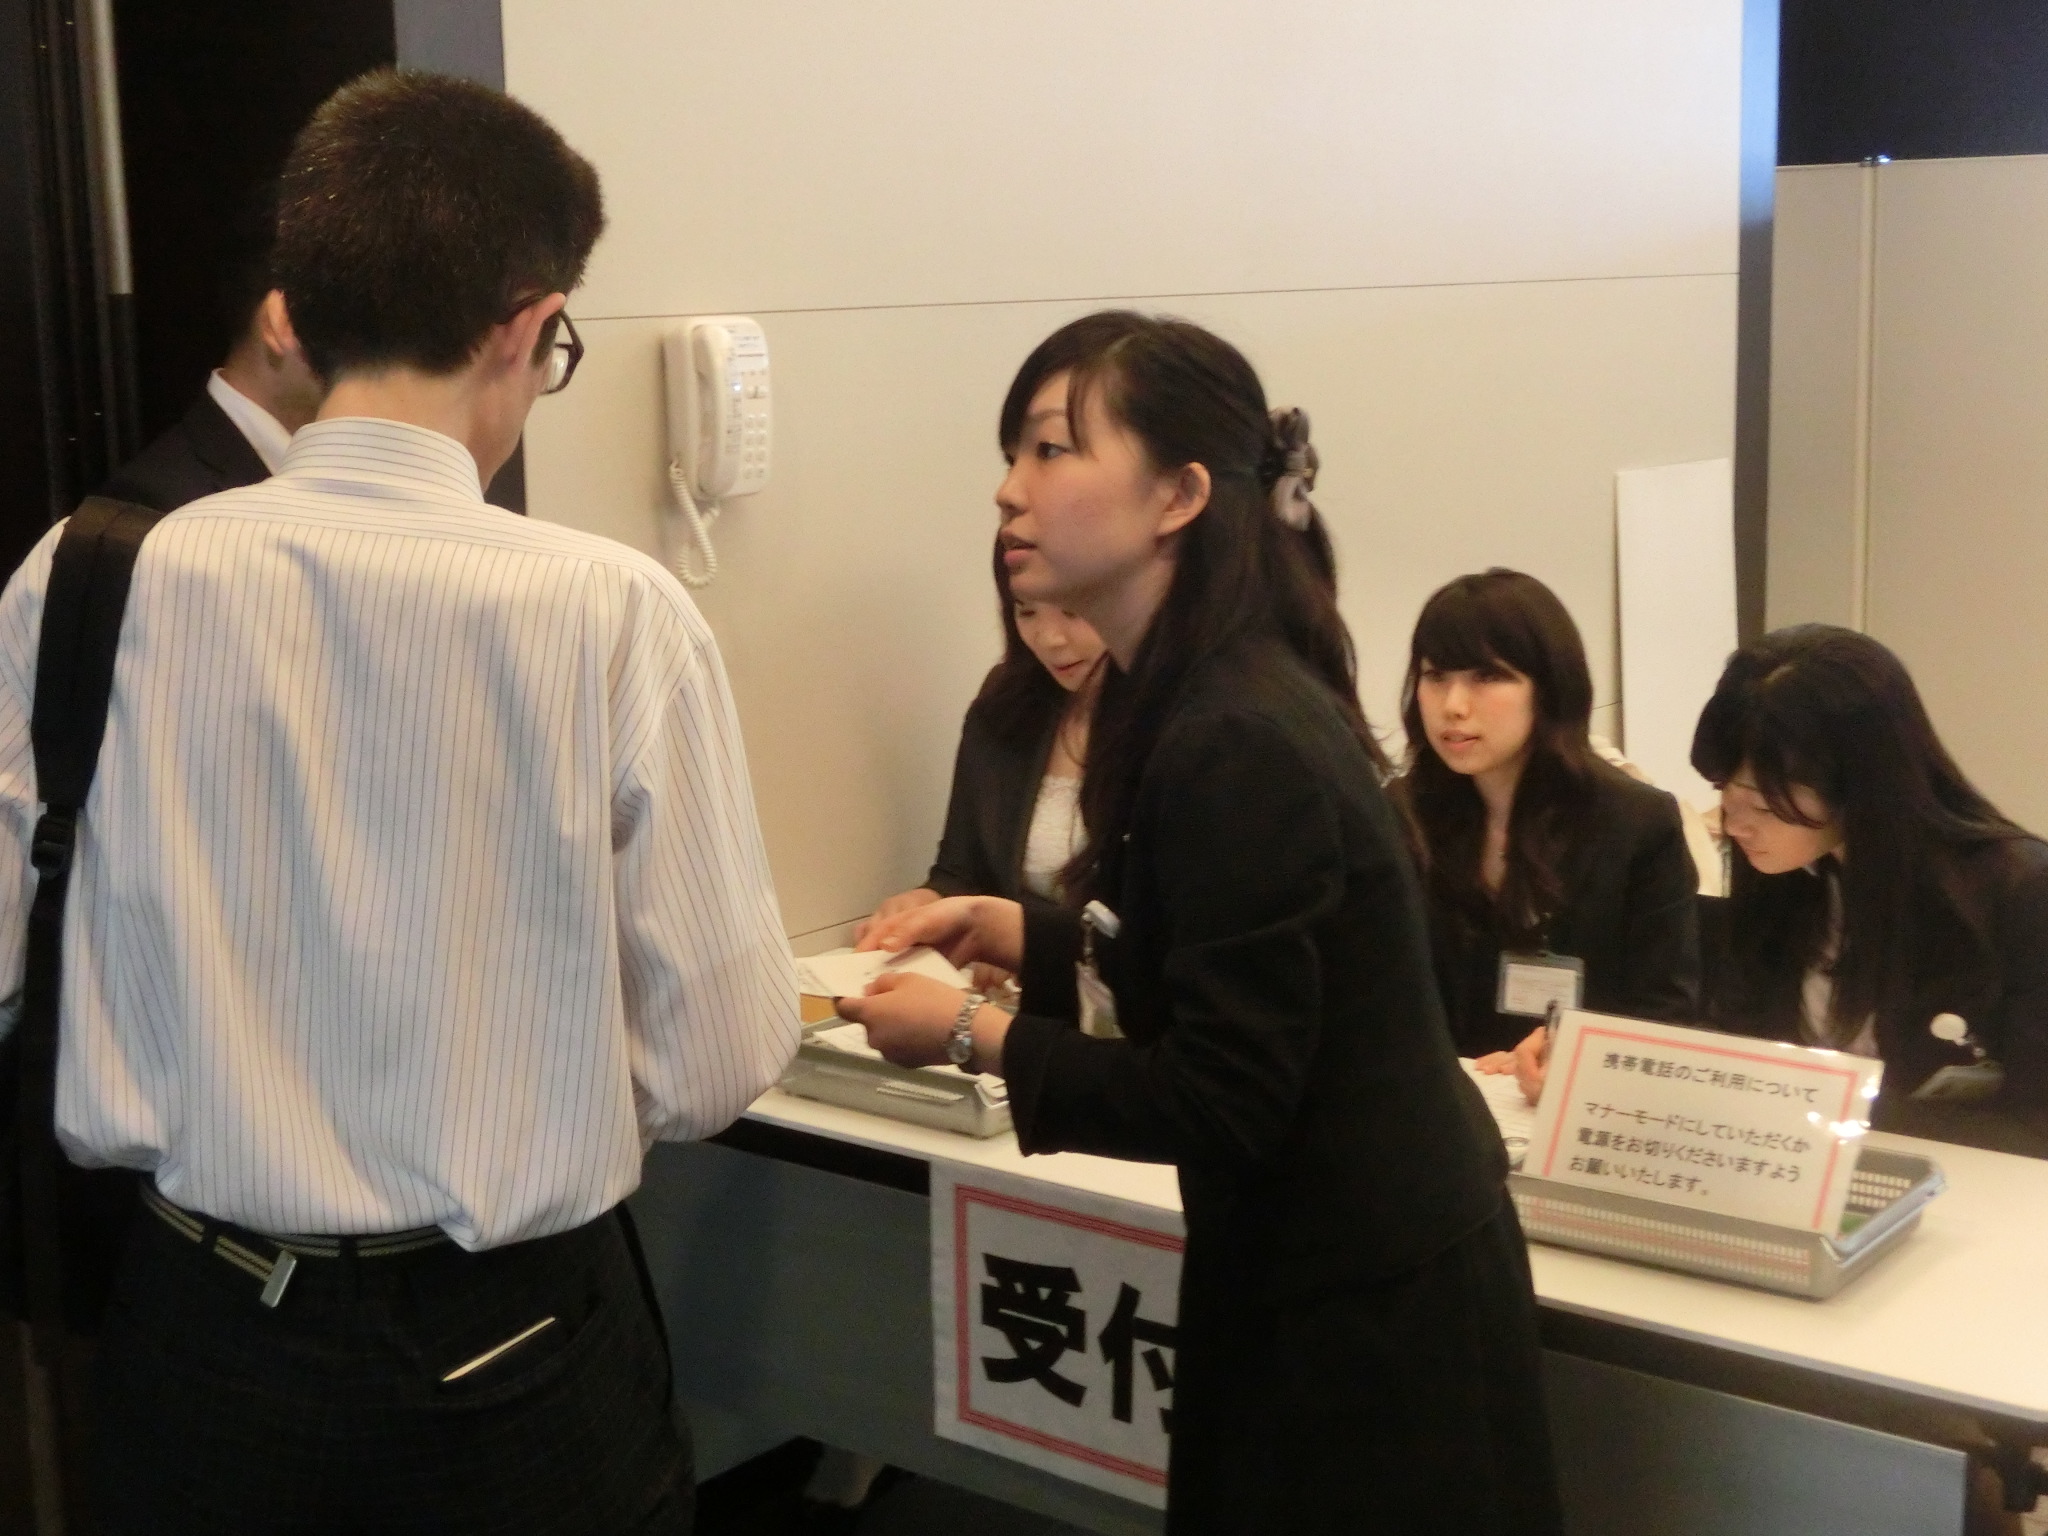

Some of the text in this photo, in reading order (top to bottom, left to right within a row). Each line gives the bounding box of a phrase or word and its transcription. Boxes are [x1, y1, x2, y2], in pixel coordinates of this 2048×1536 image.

[1603, 1052, 1819, 1103] 携帯電話のご利用について
[1585, 1101, 1810, 1155] マナーモードにしていただくか
[1569, 1156, 1709, 1196] お願いいたします。
[1577, 1127, 1801, 1183] 電源をお切りくださいますよう
